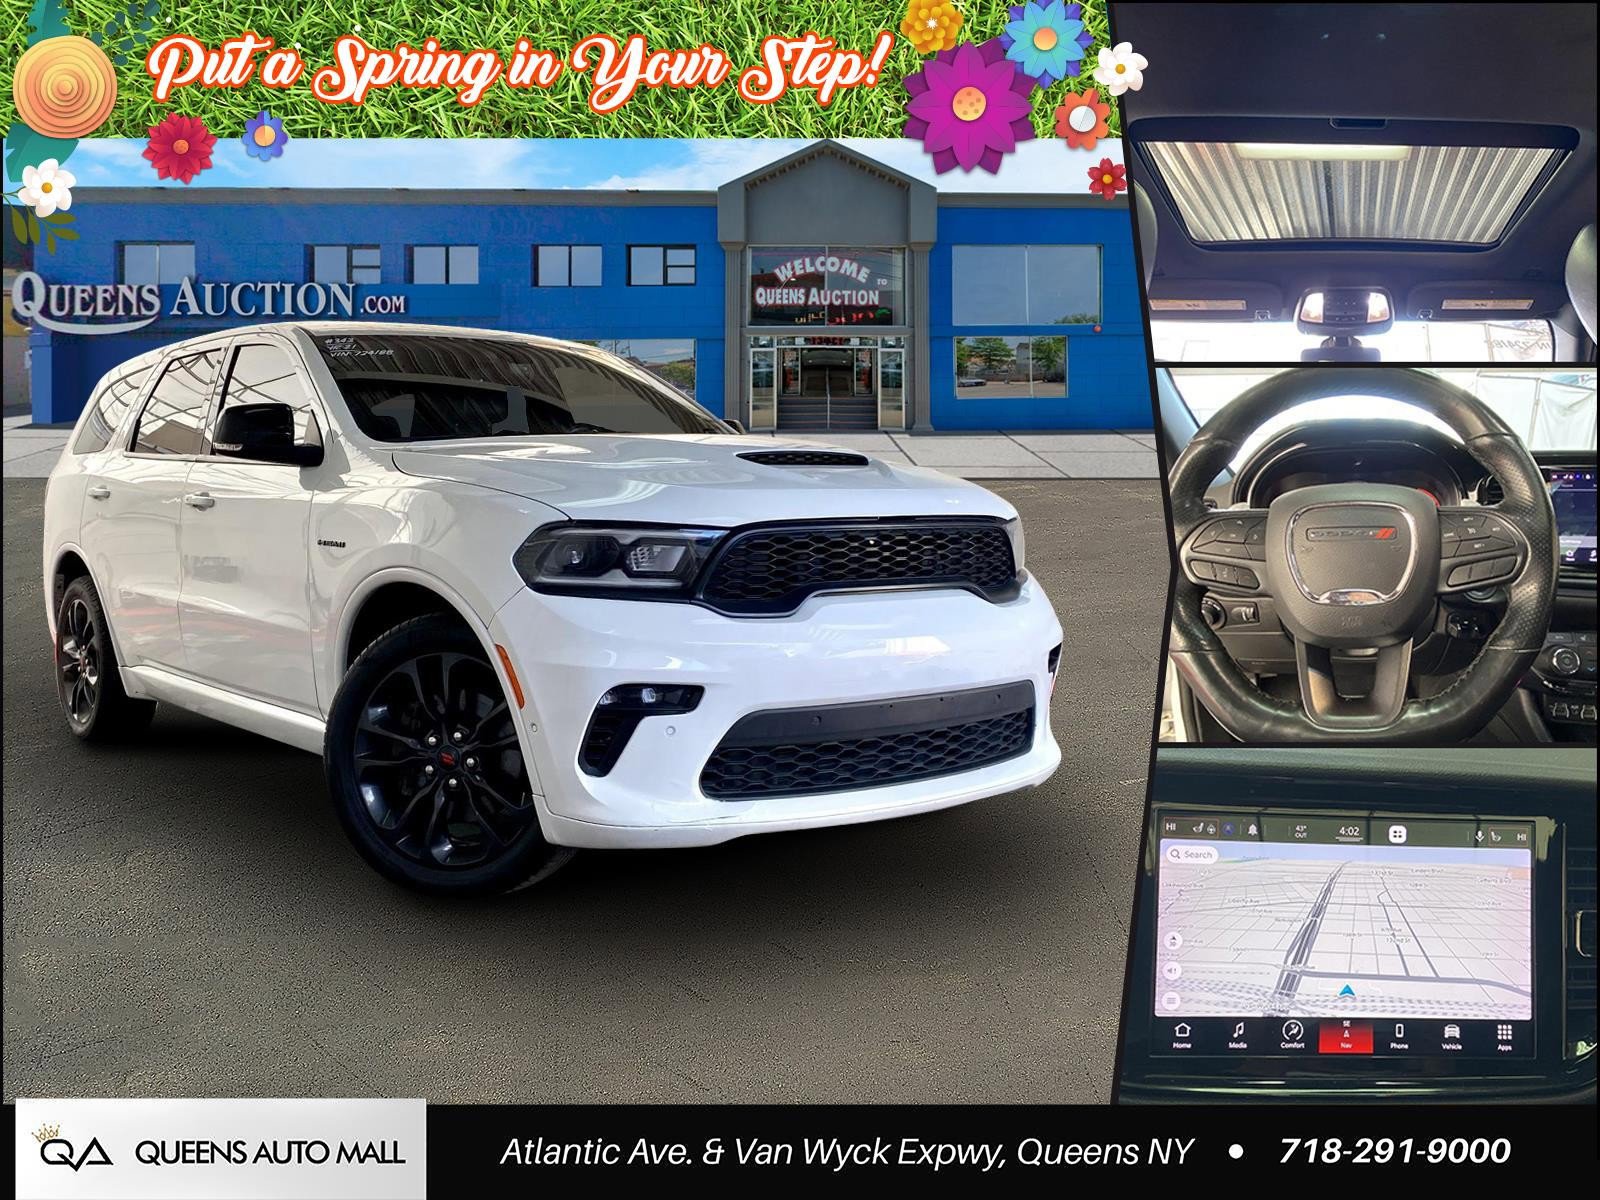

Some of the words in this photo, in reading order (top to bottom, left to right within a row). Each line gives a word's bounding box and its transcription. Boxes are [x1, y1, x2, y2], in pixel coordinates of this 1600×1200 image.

[774, 256, 870, 283] WELCOME
[755, 287, 806, 306] QUEENS
[808, 287, 879, 306] AUCTION
[12, 271, 161, 335] QUEENS
[170, 276, 355, 316] AUCTION
[1165, 823, 1176, 831] HI
[1339, 826, 1360, 836] 4:02
[1516, 833, 1527, 841] HI
[1184, 850, 1213, 859] Search
[1173, 1041, 1192, 1049] Home
[1228, 1041, 1248, 1049] Media
[1280, 1041, 1305, 1049] Comfort
[1340, 1041, 1353, 1049] Nav
[1390, 1042, 1409, 1050] Phone
[1441, 1042, 1463, 1051] Vehicle
[1497, 1043, 1513, 1053] Apps
